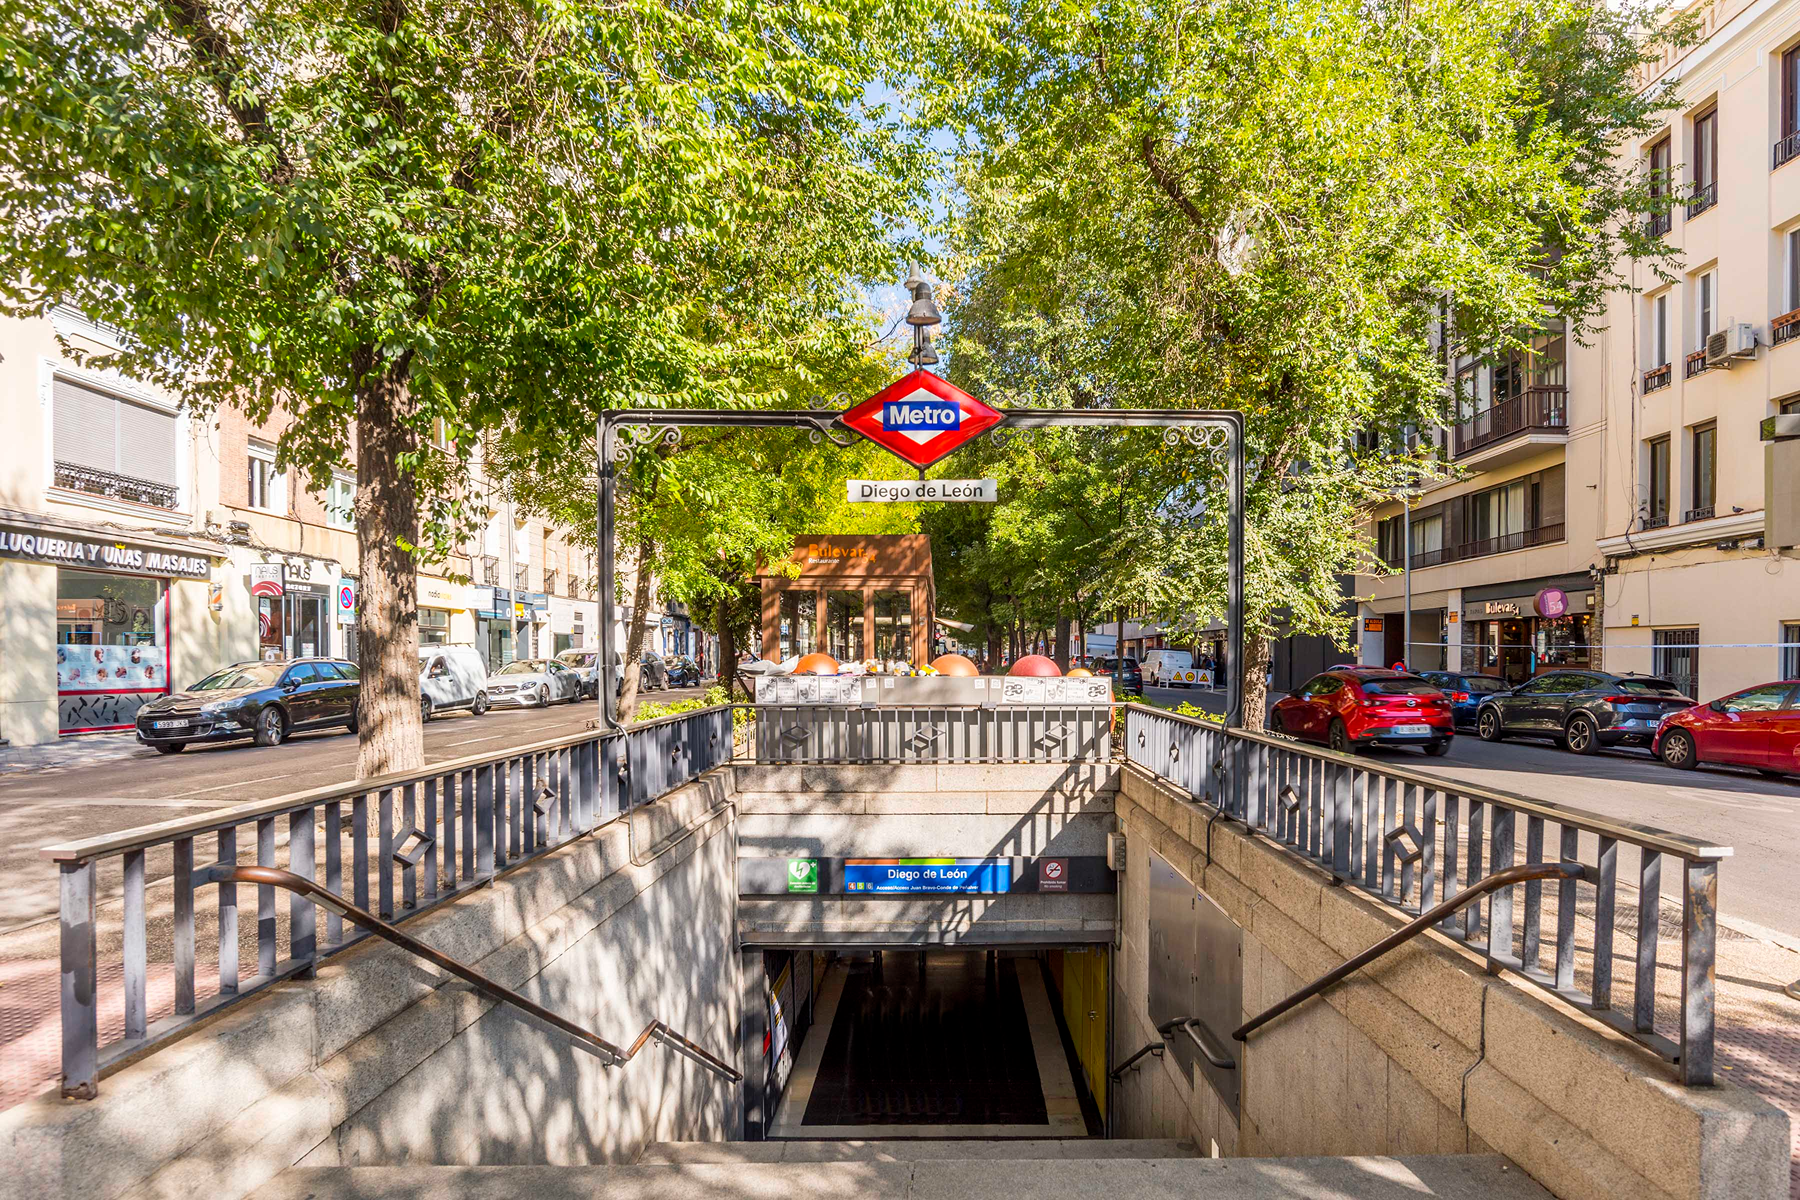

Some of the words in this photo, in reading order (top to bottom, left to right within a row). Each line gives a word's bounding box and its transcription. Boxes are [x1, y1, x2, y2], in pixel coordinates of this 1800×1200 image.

[890, 405, 956, 425] Metro
[861, 484, 910, 502] Diego
[915, 484, 936, 498] de
[942, 484, 983, 498] León
[87, 543, 100, 560] Y
[147, 552, 207, 574] MASAJES
[808, 543, 864, 558] Bulevar
[861, 553, 876, 564] 54
[1485, 602, 1513, 614] Bulevar
[1549, 600, 1564, 612] 54
[887, 869, 920, 881] Diego
[923, 869, 937, 879] de
[940, 868, 968, 879] León
